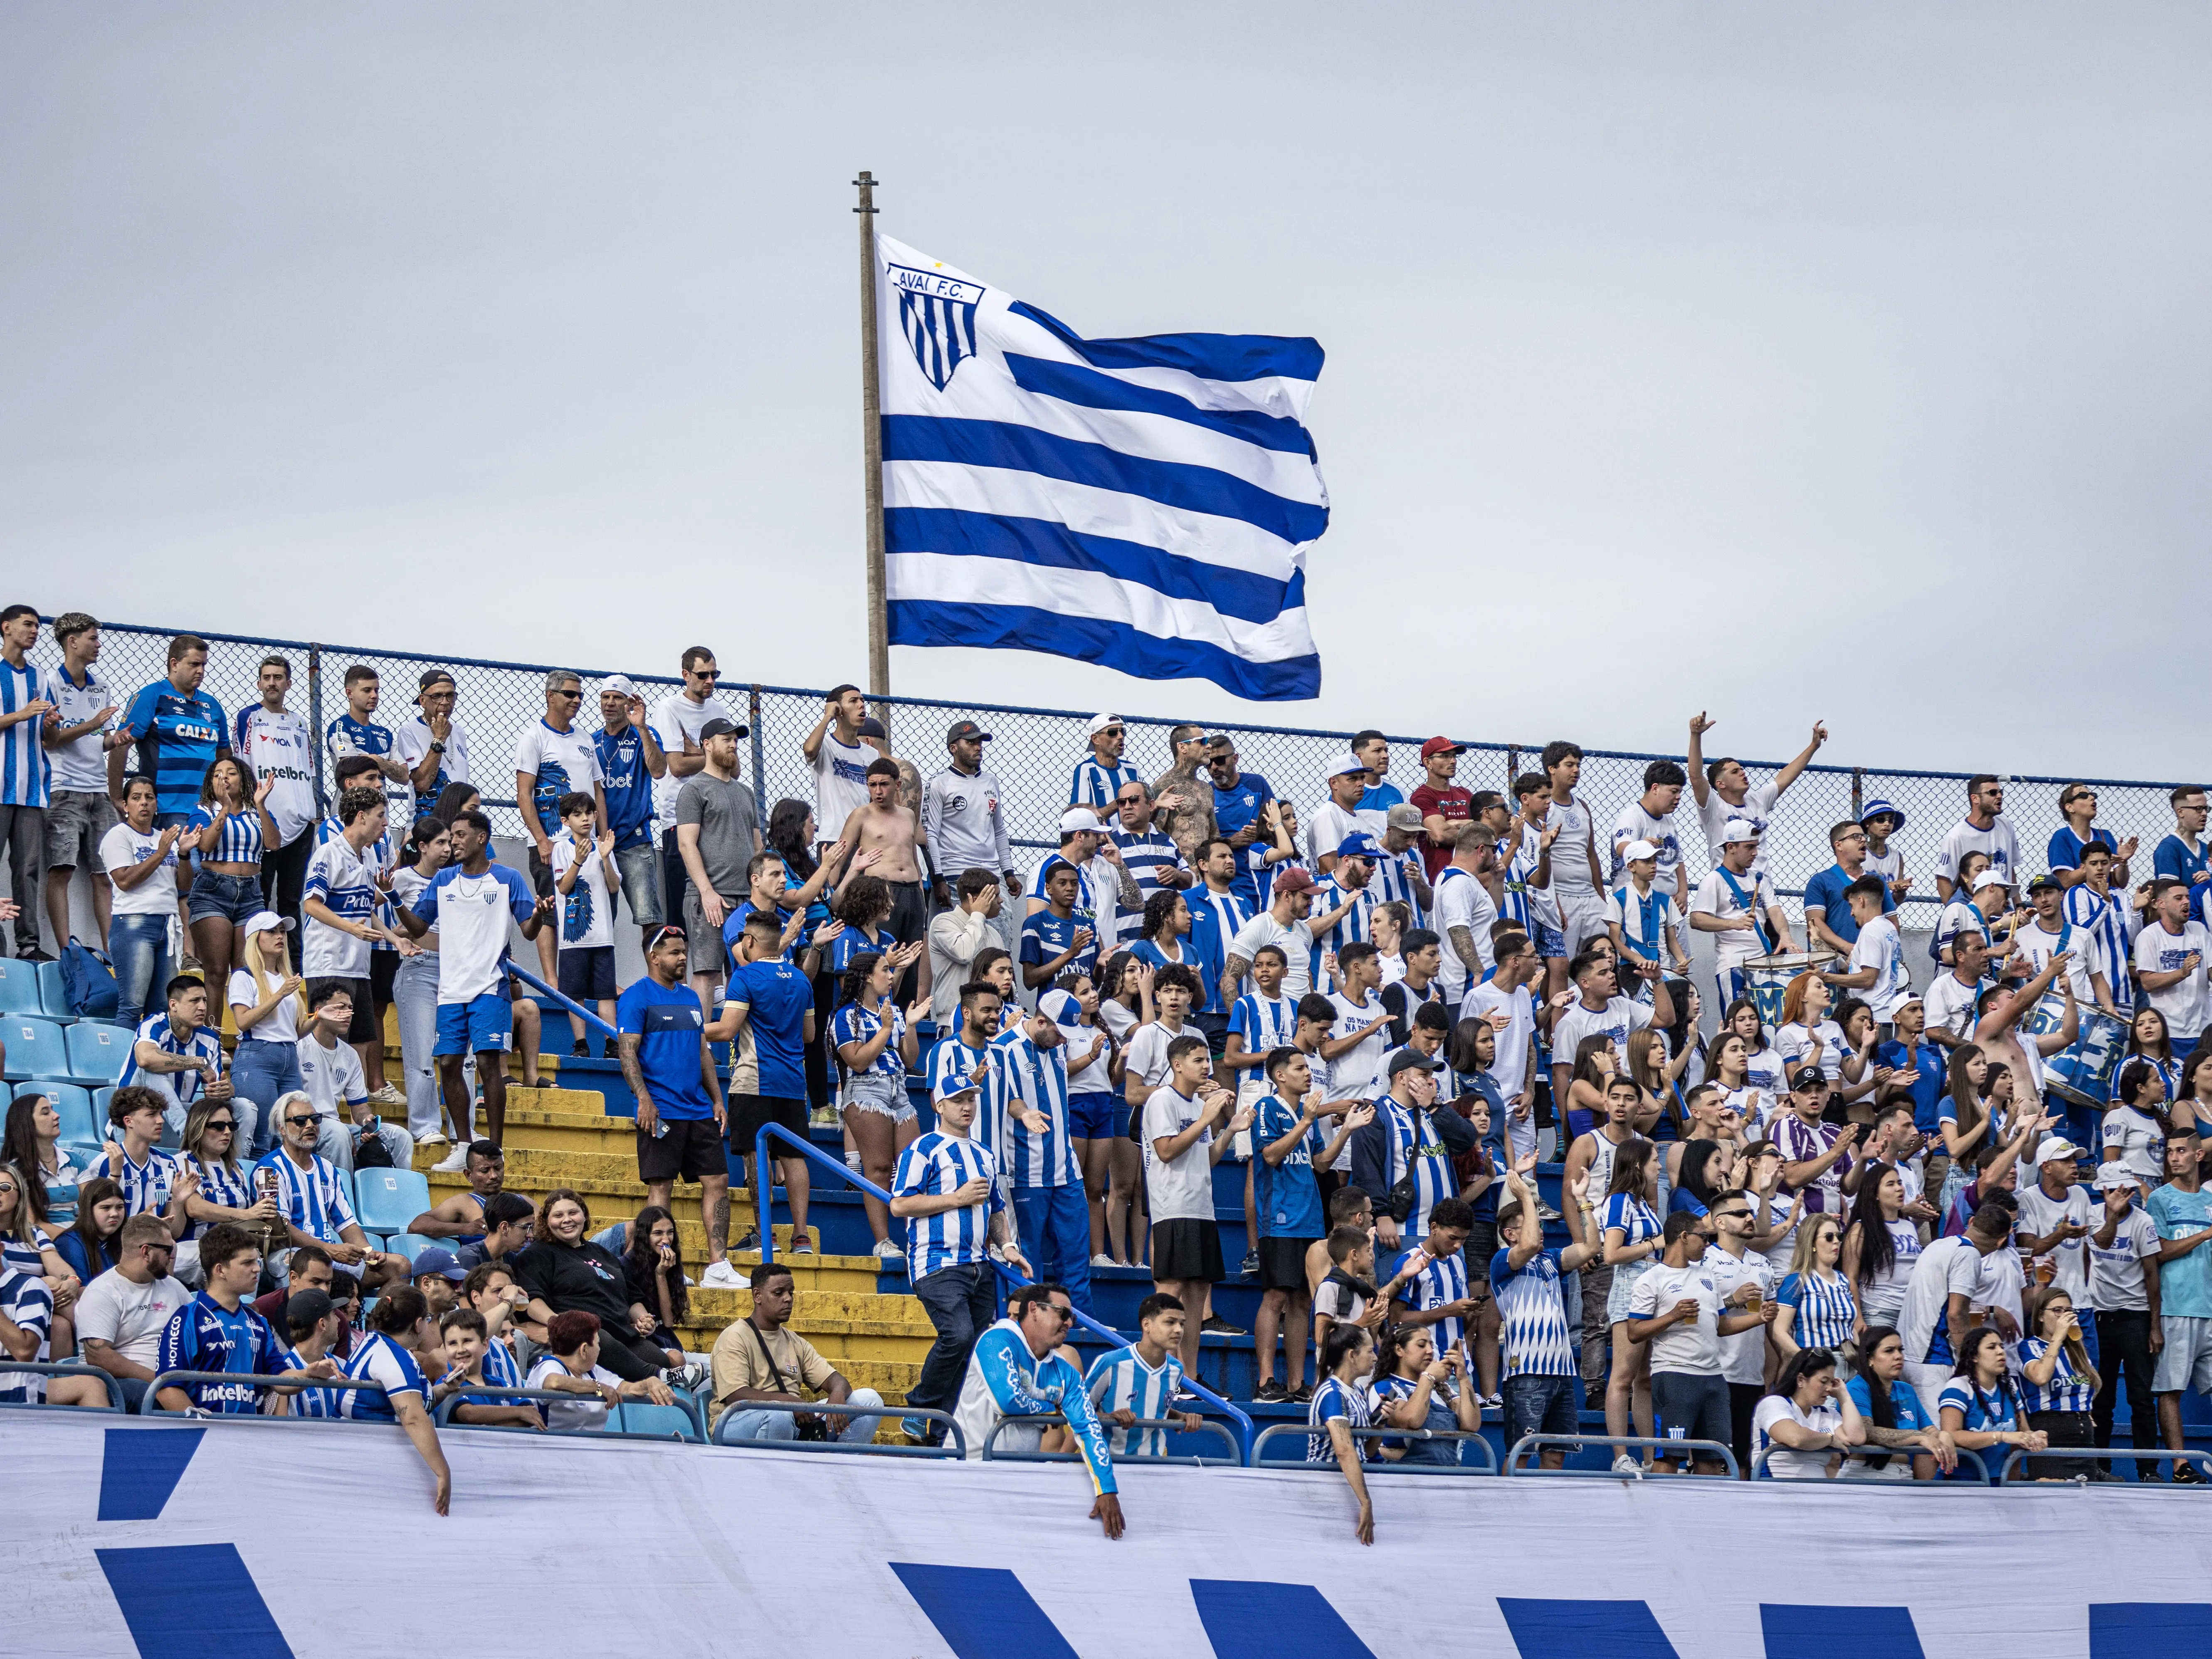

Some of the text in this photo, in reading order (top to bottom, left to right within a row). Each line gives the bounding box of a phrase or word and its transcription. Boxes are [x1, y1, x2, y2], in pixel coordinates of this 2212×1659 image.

[899, 272, 963, 299] AVAÍ F.C.
[175, 723, 219, 742] CAIXA
[600, 773, 633, 788] xbet
[954, 797, 965, 807] 28
[1345, 1023, 1357, 1033] NA
[1276, 1111, 1292, 1120] WOA
[1405, 1139, 1447, 1160] pxbet
[169, 1316, 182, 1368] KOMECO
[2050, 1374, 2091, 1391] pixbe
[202, 1383, 264, 1407] intelbr
